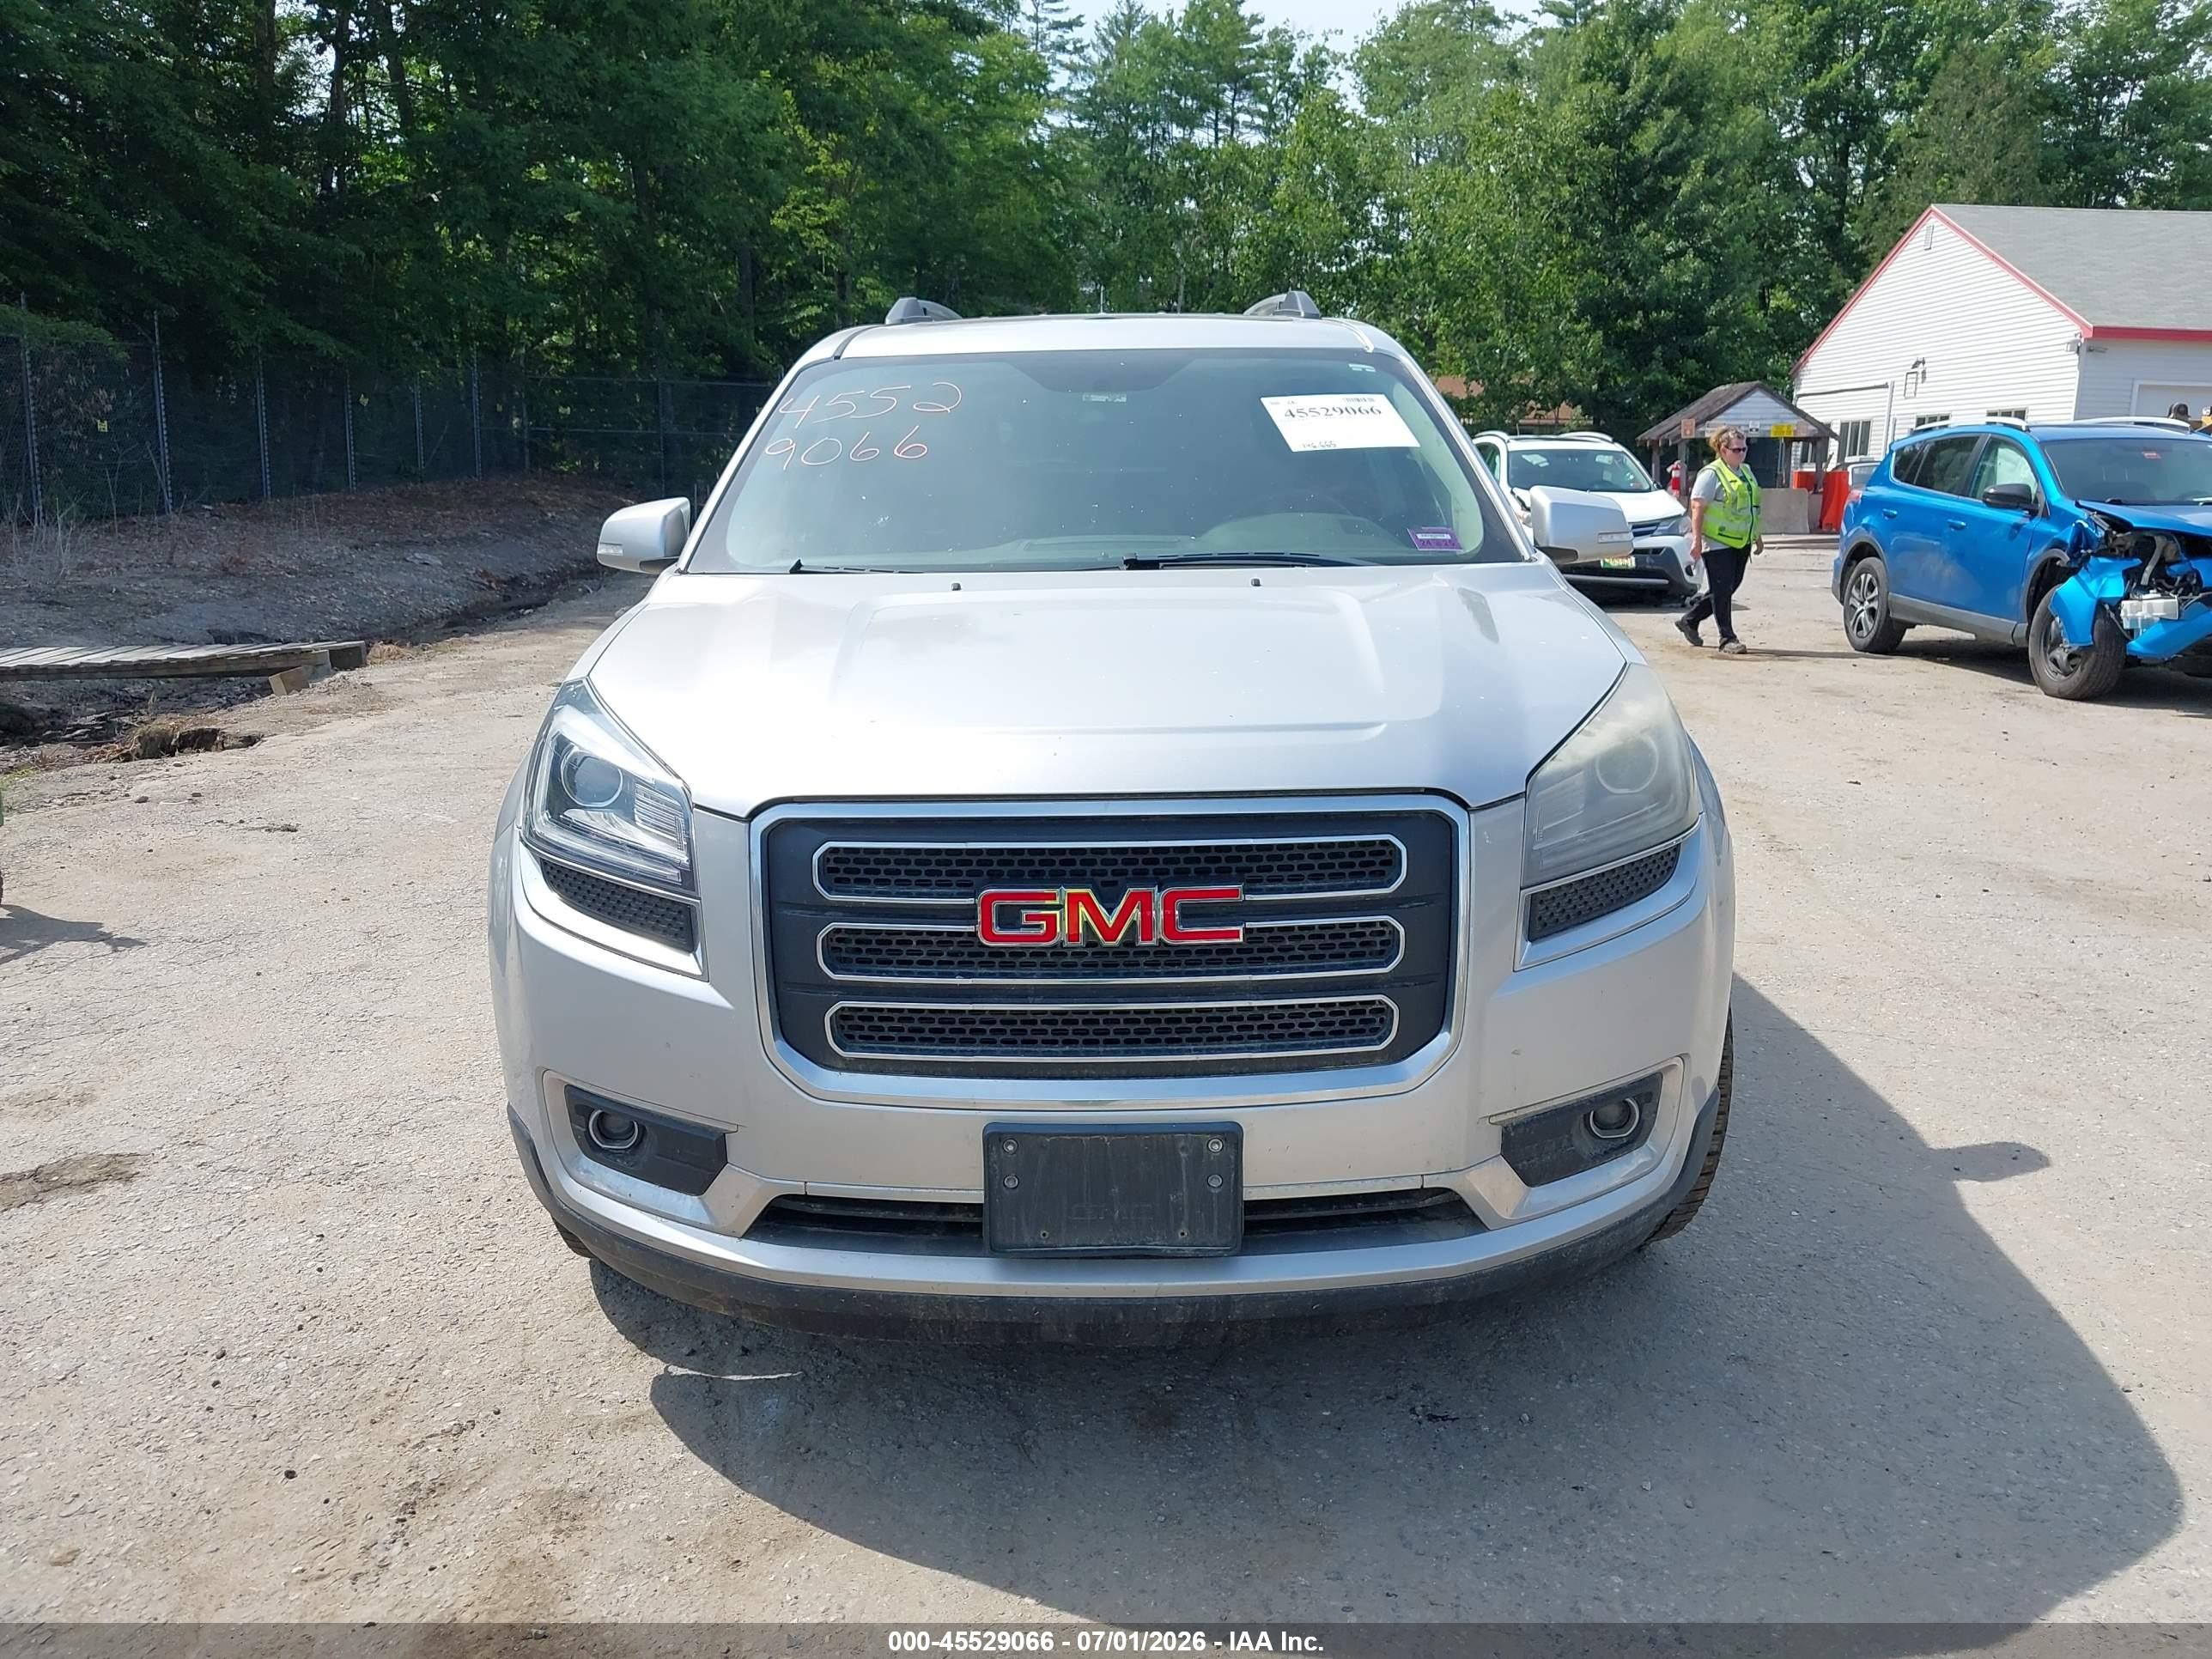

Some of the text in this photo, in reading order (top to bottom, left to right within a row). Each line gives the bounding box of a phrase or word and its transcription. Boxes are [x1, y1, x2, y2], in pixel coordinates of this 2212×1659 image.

[779, 382, 962, 429] 4552
[1285, 406, 1382, 418] 45529066
[765, 425, 928, 471] 9066
[977, 884, 1245, 947] GMC
